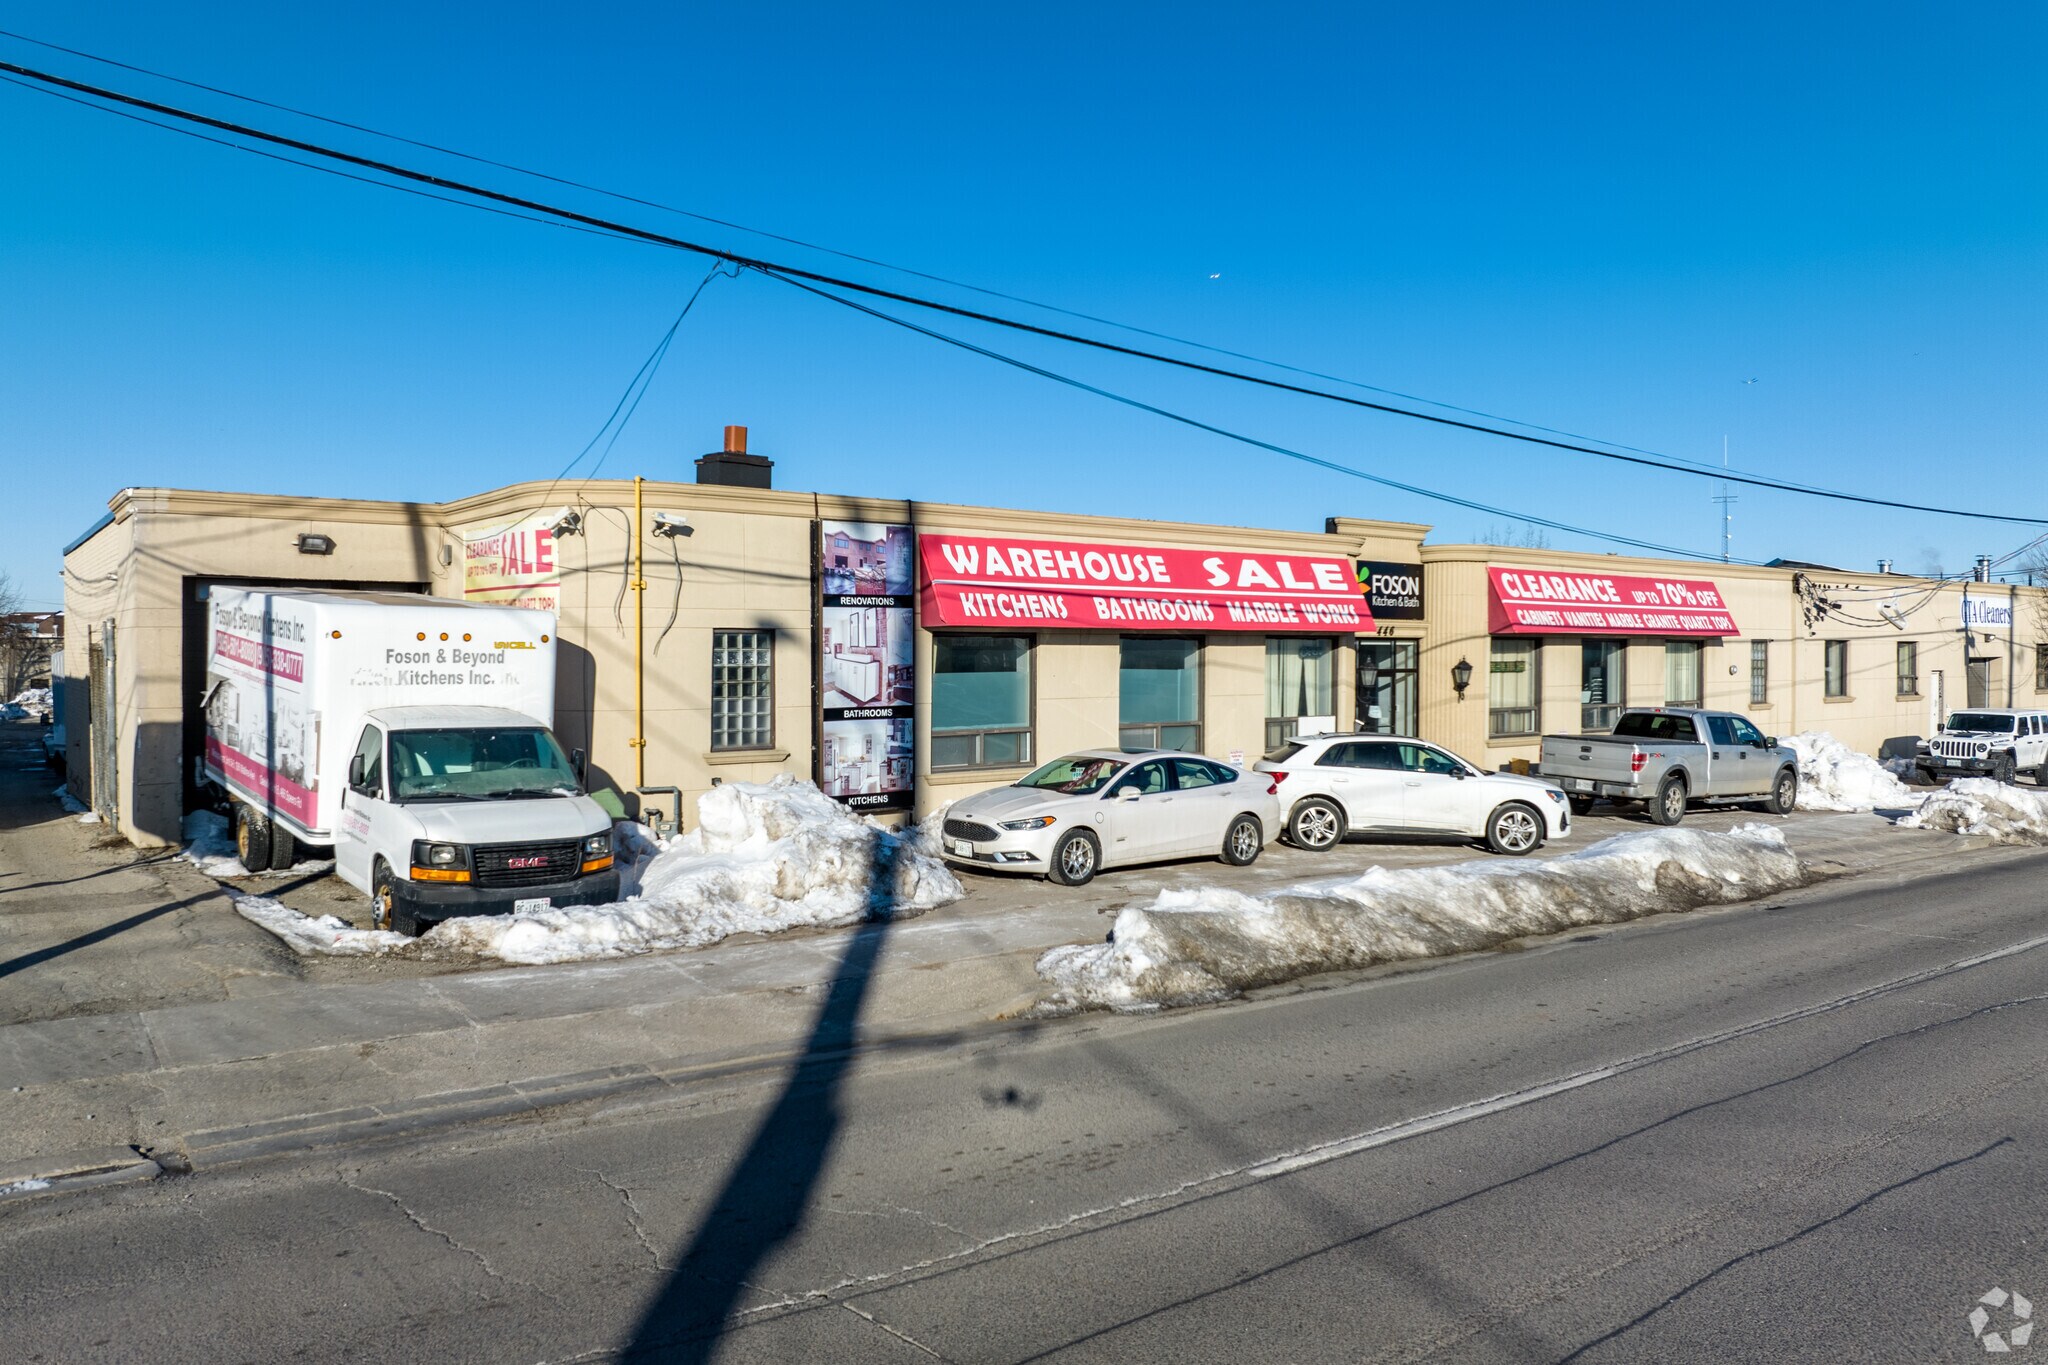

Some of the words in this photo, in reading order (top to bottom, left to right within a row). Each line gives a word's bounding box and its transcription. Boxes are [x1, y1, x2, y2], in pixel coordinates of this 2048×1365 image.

[466, 538, 499, 560] CLEARANCE
[501, 529, 554, 577] SALE
[941, 543, 1171, 583] WAREHOUSE
[1202, 557, 1348, 592] SALE
[1372, 574, 1420, 596] FOSON
[1500, 572, 1622, 603] CLEARANCE
[1632, 590, 1646, 604] UP
[1646, 591, 1660, 605] TO
[1655, 582, 1697, 606] 70%
[1695, 591, 1719, 607] OFF
[538, 597, 555, 610] TOPS
[840, 596, 894, 606] RENOVATIONS
[959, 592, 1069, 620] KITCHENS
[1093, 596, 1215, 623] BATHROOMS
[1225, 600, 1298, 624] MARBLE
[1299, 602, 1361, 626] WORKS
[1372, 595, 1398, 607] Kitchen
[1398, 596, 1404, 607] &
[1404, 596, 1420, 607] Bath
[1516, 608, 1562, 626] CABINETS
[1563, 611, 1604, 627] VANITIES
[1605, 612, 1644, 628] MARBLE
[1644, 613, 1678, 630] GRANITE
[1679, 614, 1713, 630] QUARTZ
[1713, 616, 1733, 630] TOPS
[1979, 600, 2012, 625] Cleaners
[293, 616, 306, 643] Inc.
[1376, 626, 1396, 636] 446
[386, 648, 430, 664] Foson
[436, 648, 447, 664] &
[452, 648, 505, 668] Beyond
[398, 670, 464, 686] Kitchens
[469, 670, 495, 686] Inc.
[843, 708, 893, 718] BATHROOMS
[848, 794, 889, 806] KITCHENS
[508, 856, 548, 868] GMC
